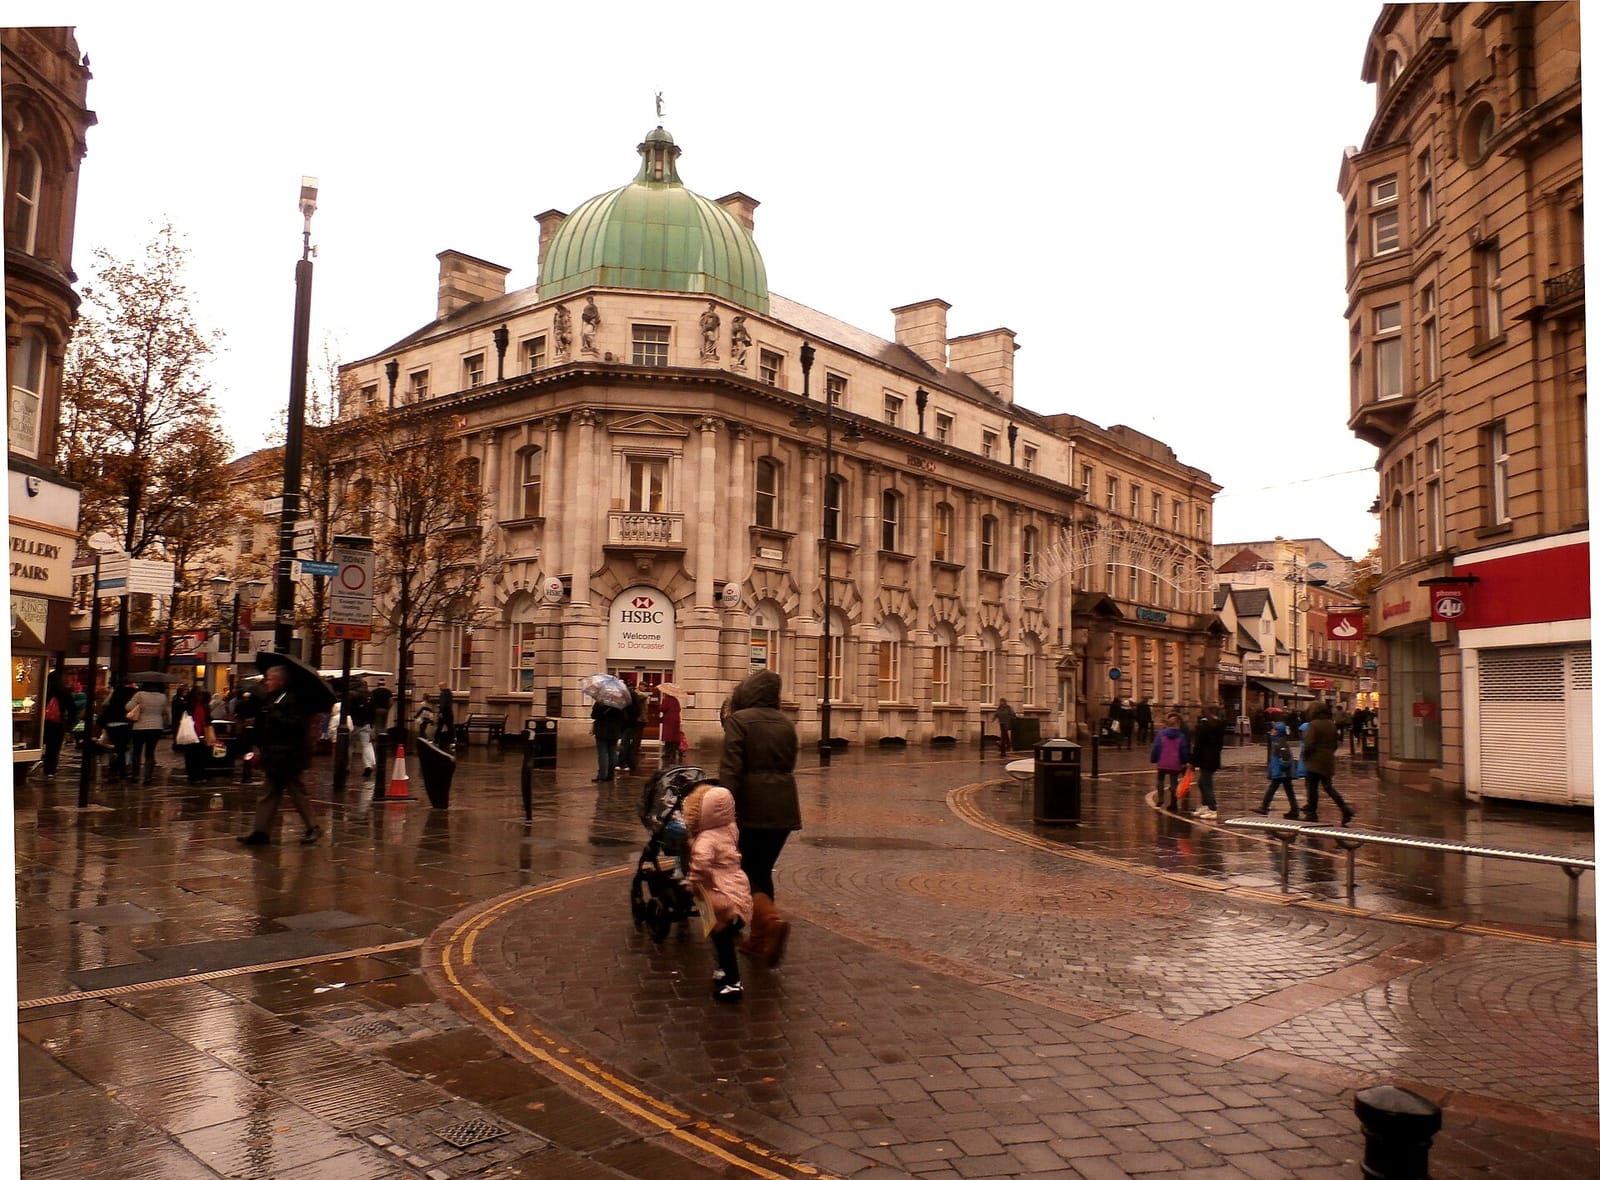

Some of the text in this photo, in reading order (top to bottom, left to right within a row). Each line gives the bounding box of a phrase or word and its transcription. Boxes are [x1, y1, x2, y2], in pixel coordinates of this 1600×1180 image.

[546, 589, 562, 597] HSBC
[723, 594, 738, 602] HSBC
[621, 610, 664, 624] HSBC
[622, 632, 661, 641] Welcome
[617, 641, 665, 650] to Doncaster
